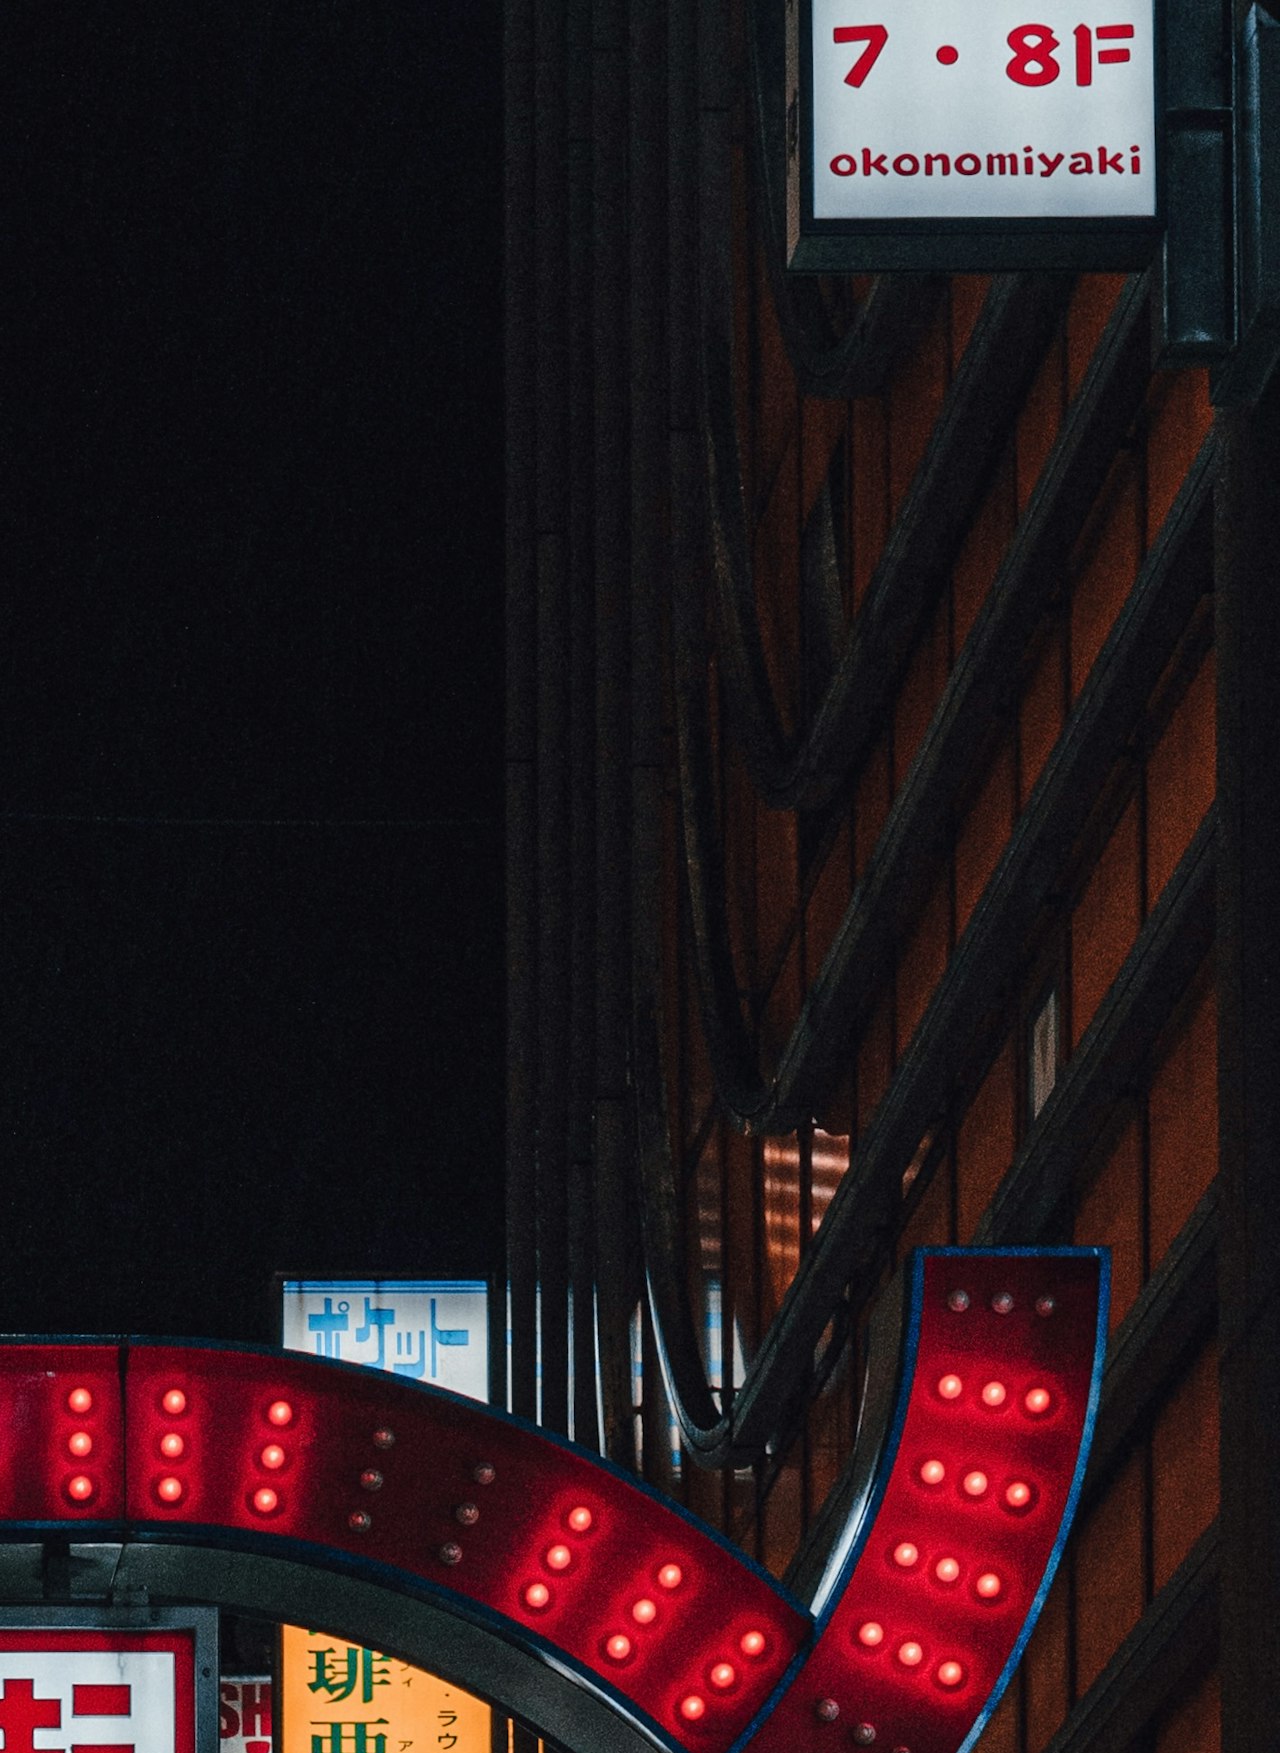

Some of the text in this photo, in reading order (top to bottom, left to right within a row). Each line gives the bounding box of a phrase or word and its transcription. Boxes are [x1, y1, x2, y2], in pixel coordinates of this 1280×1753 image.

[829, 146, 1141, 177] okonomiyaki
[308, 1297, 469, 1378] ポケット
